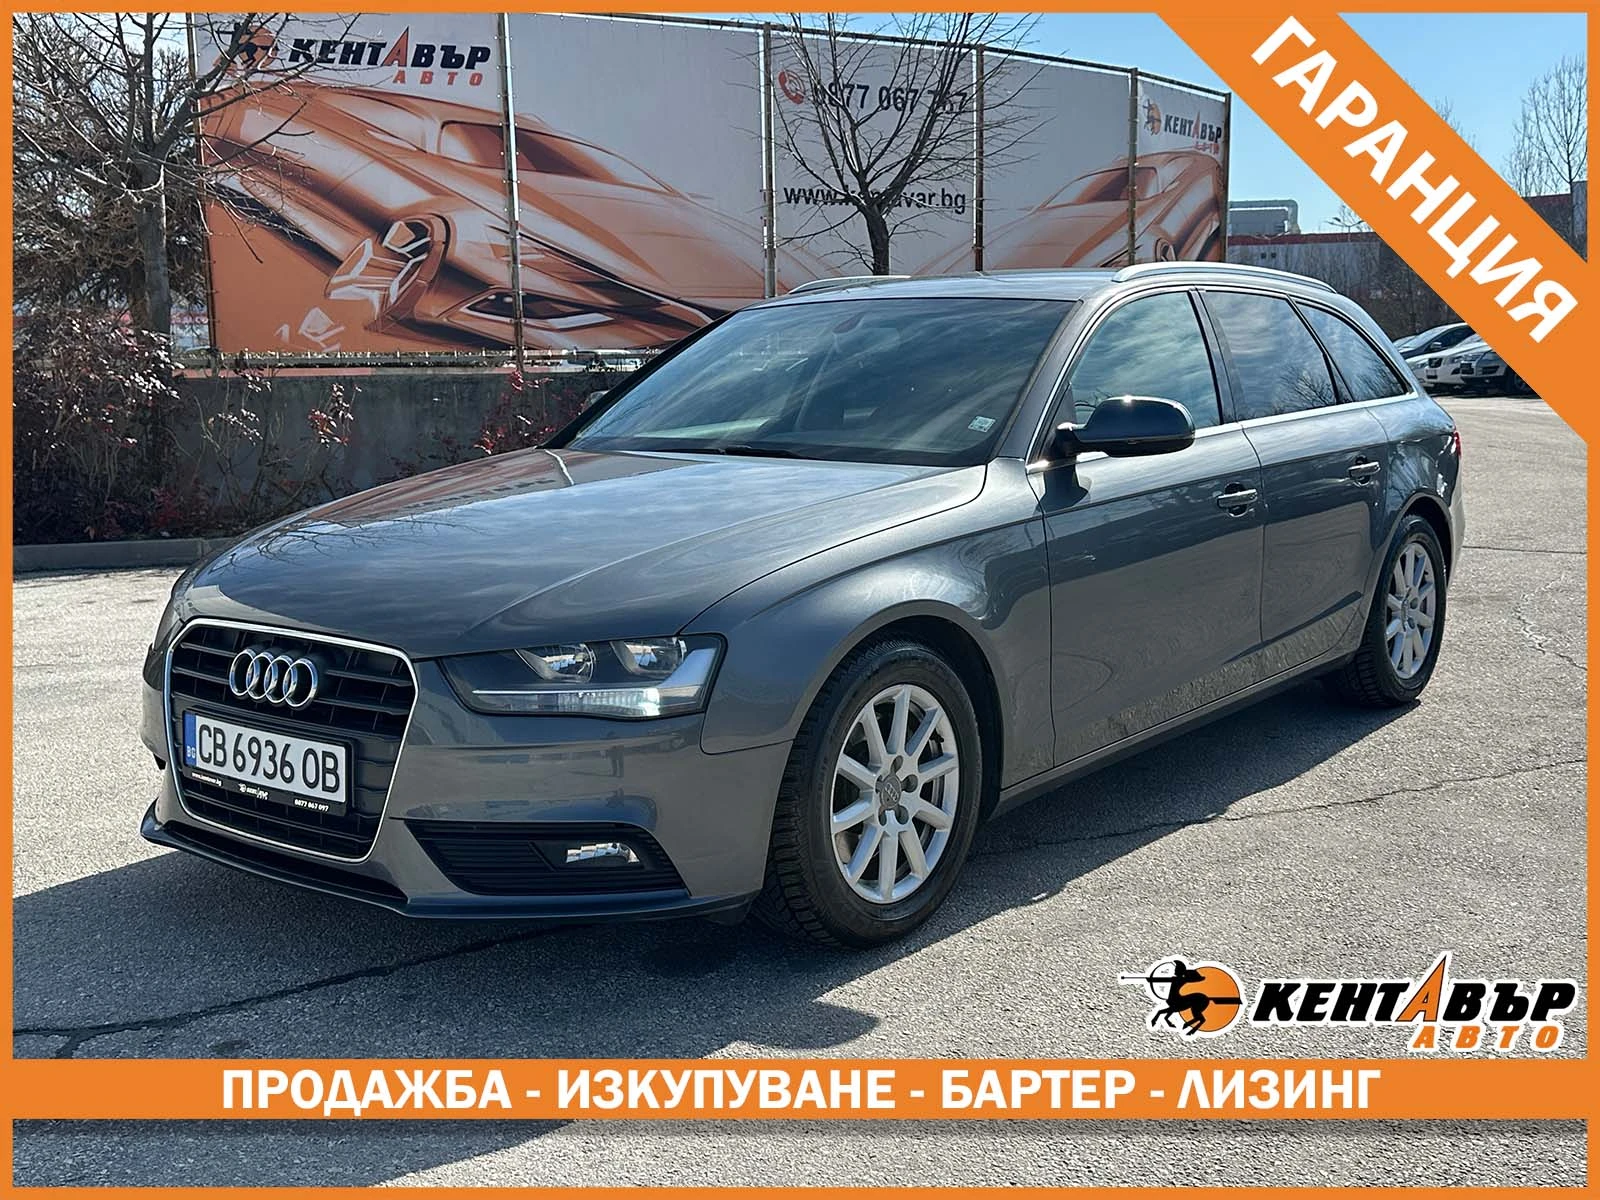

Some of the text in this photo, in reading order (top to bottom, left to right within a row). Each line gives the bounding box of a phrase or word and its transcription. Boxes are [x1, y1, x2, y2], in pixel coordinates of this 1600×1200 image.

[289, 26, 491, 70] КЕНТАВЪР
[392, 70, 483, 87] АВТО
[878, 86, 919, 112] 067
[1164, 111, 1222, 143] КЕНТАВЪР
[232, 732, 296, 784] 6936
